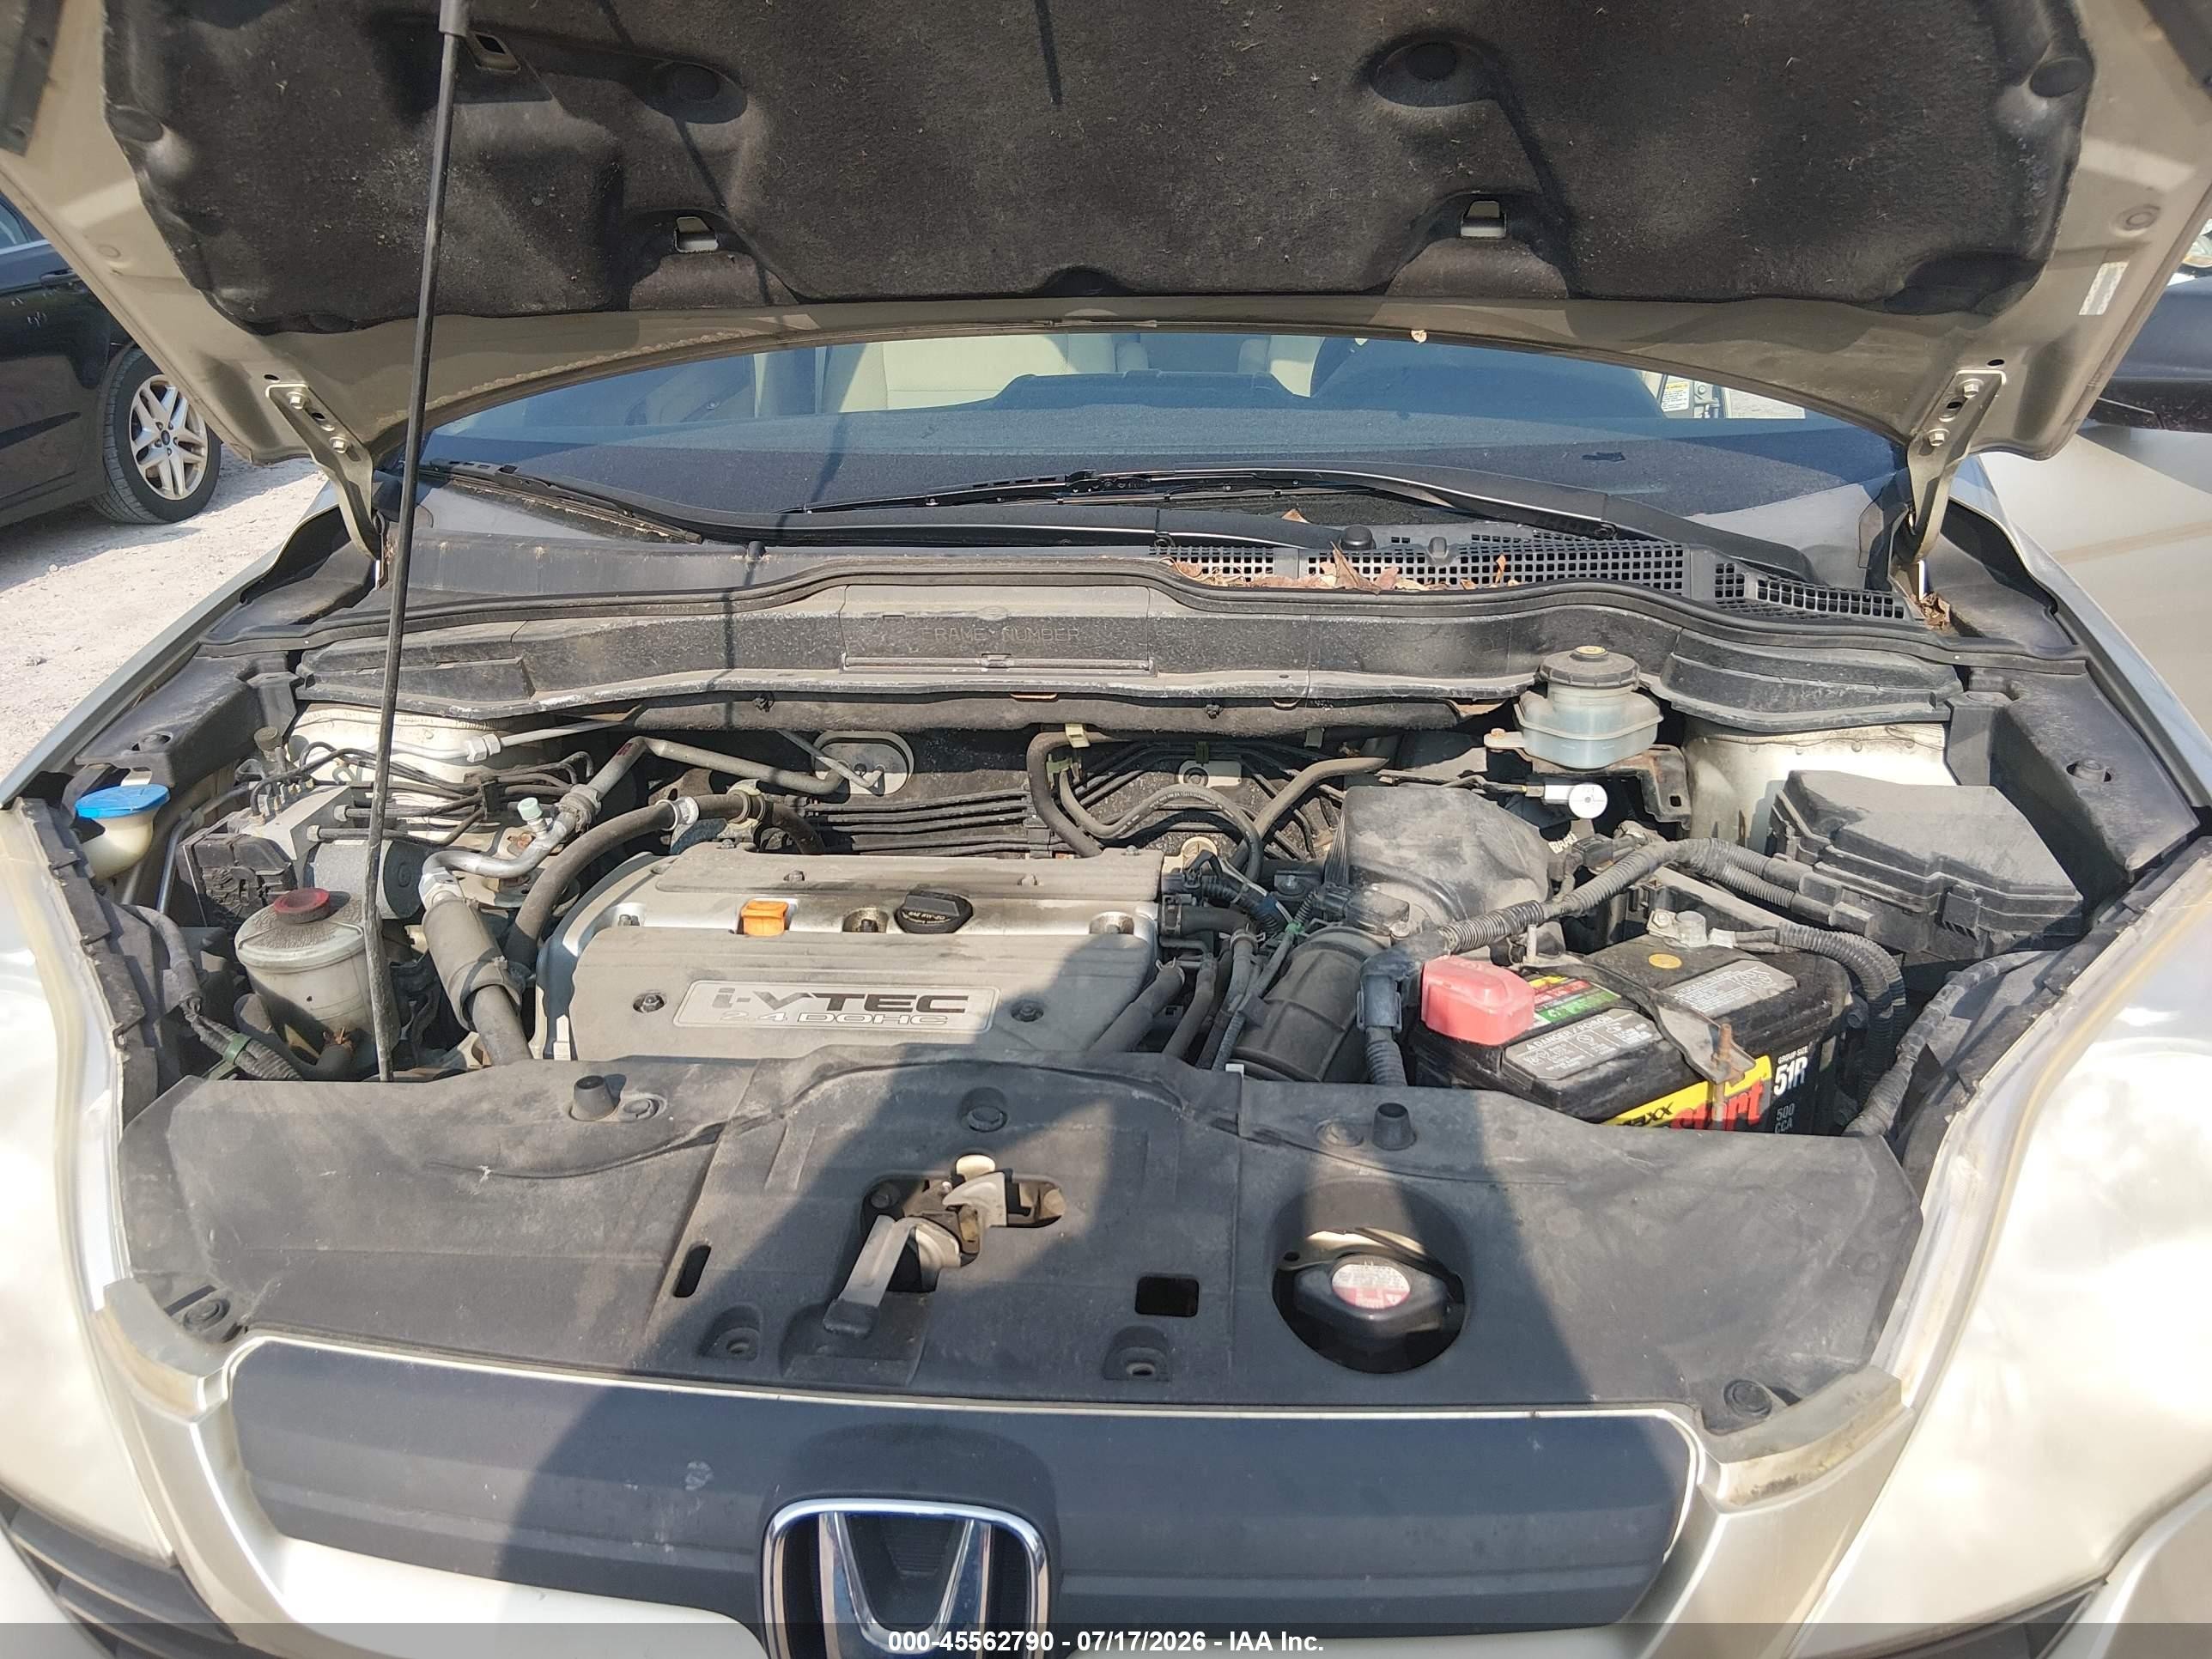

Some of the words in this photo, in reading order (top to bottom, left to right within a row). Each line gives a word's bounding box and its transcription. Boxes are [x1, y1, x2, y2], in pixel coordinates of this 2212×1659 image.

[919, 627, 987, 641] FRAME
[1001, 626, 1080, 641] NUMBER
[712, 988, 969, 1013] i-VTEC
[720, 1011, 787, 1022] 2.4
[797, 1013, 948, 1024] DOHC
[1532, 1030, 1572, 1046] DANGER
[1577, 1016, 1613, 1030] POISON
[1778, 1050, 1796, 1065] GROUP
[1796, 1045, 1808, 1057] SIZE
[1773, 1056, 1808, 1096] 51R
[1777, 1103, 1795, 1121] 500
[1775, 1117, 1793, 1133] CCA
